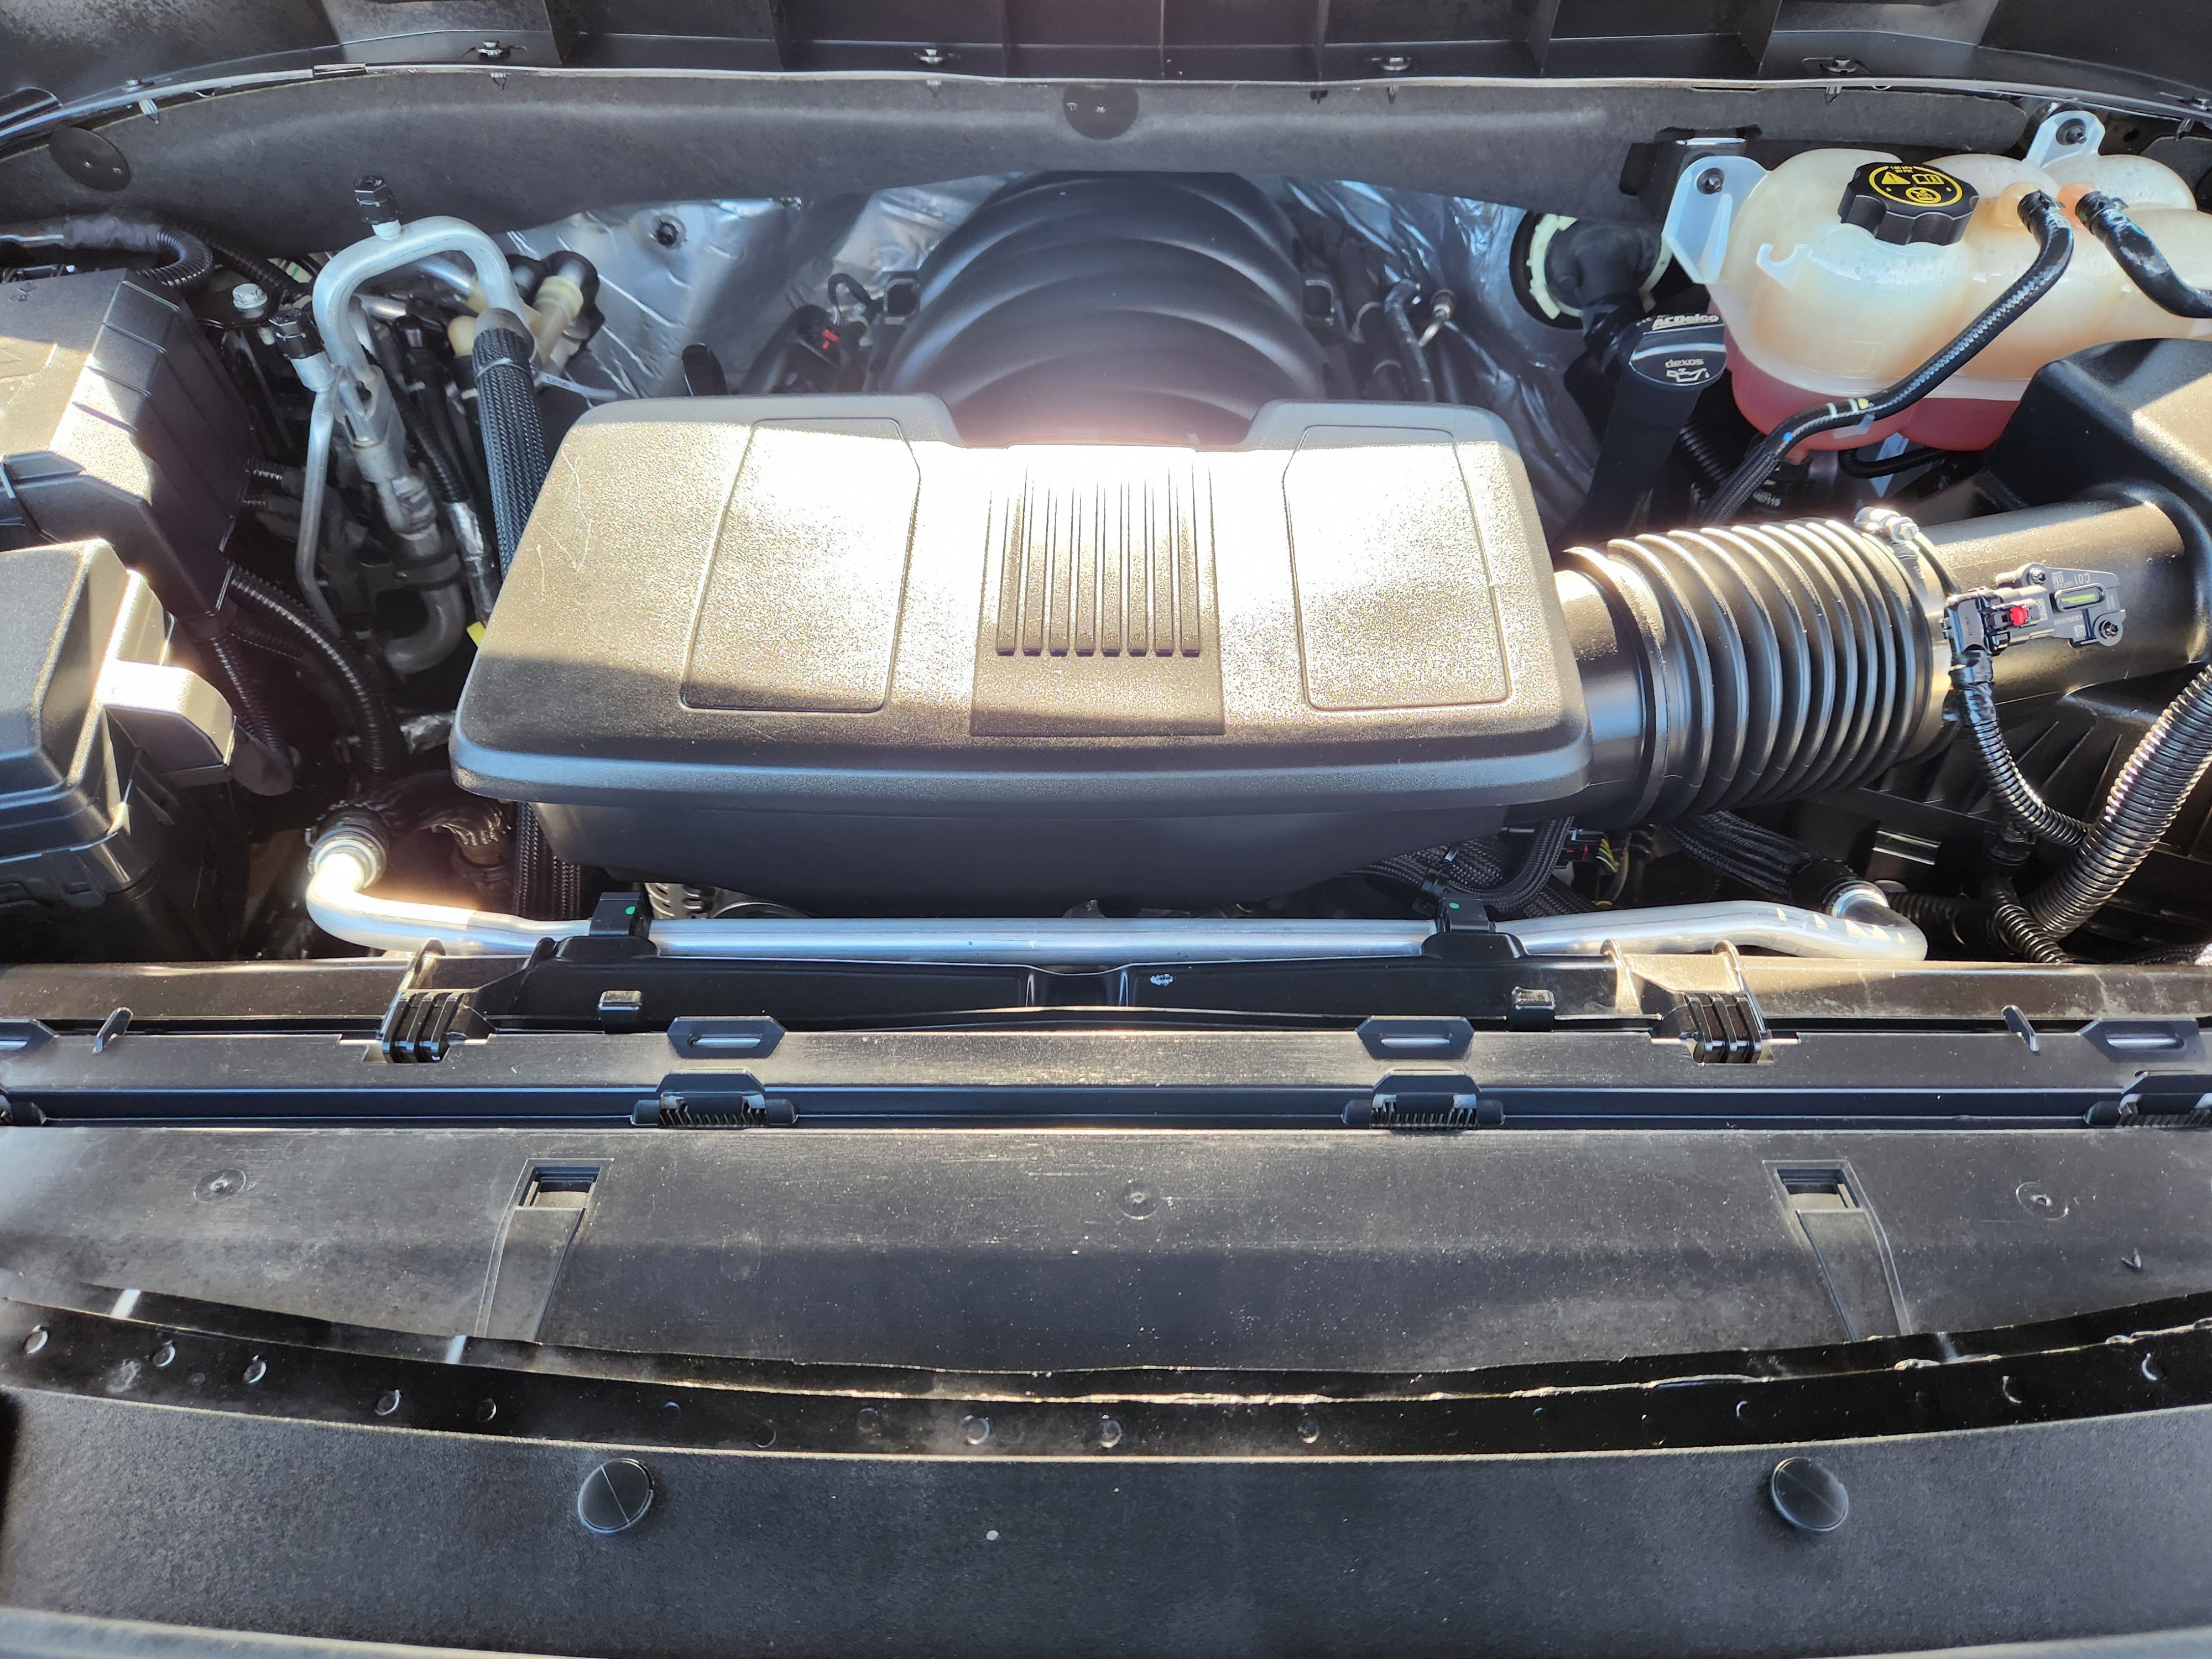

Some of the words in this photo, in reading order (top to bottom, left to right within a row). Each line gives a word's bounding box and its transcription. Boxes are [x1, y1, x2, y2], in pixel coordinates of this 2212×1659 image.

[1652, 314, 1719, 330] ACDelco
[1665, 359, 1704, 368] dexos
[2052, 573, 2064, 585] GM
